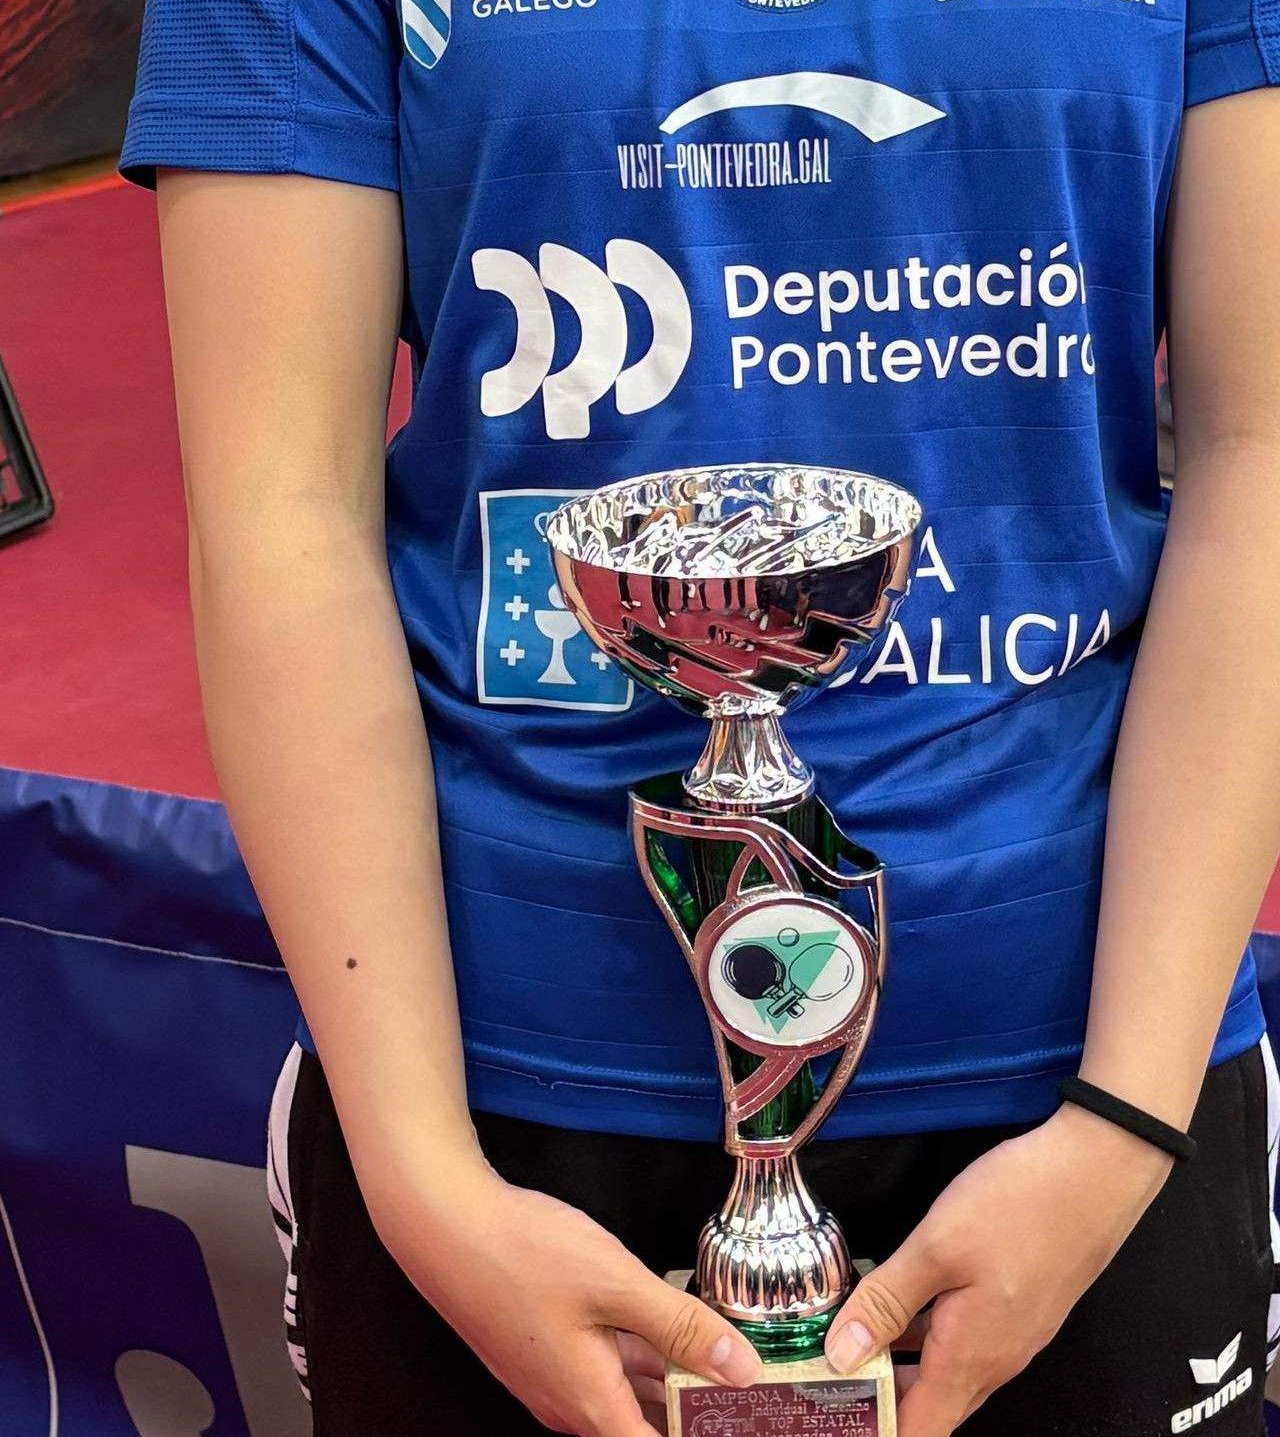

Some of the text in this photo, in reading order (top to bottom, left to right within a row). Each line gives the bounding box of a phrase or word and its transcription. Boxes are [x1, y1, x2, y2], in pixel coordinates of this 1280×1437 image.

[617, 138, 831, 189] VISIT-PONTEVEDRA.GAL
[724, 241, 1086, 332] Deputació
[828, 609, 1111, 689] ALICIA
[691, 1389, 782, 1407] CAMPEONA
[751, 1403, 807, 1417] Individual
[770, 1413, 865, 1431] TOP ESTATAL
[1171, 1367, 1252, 1435] erima
